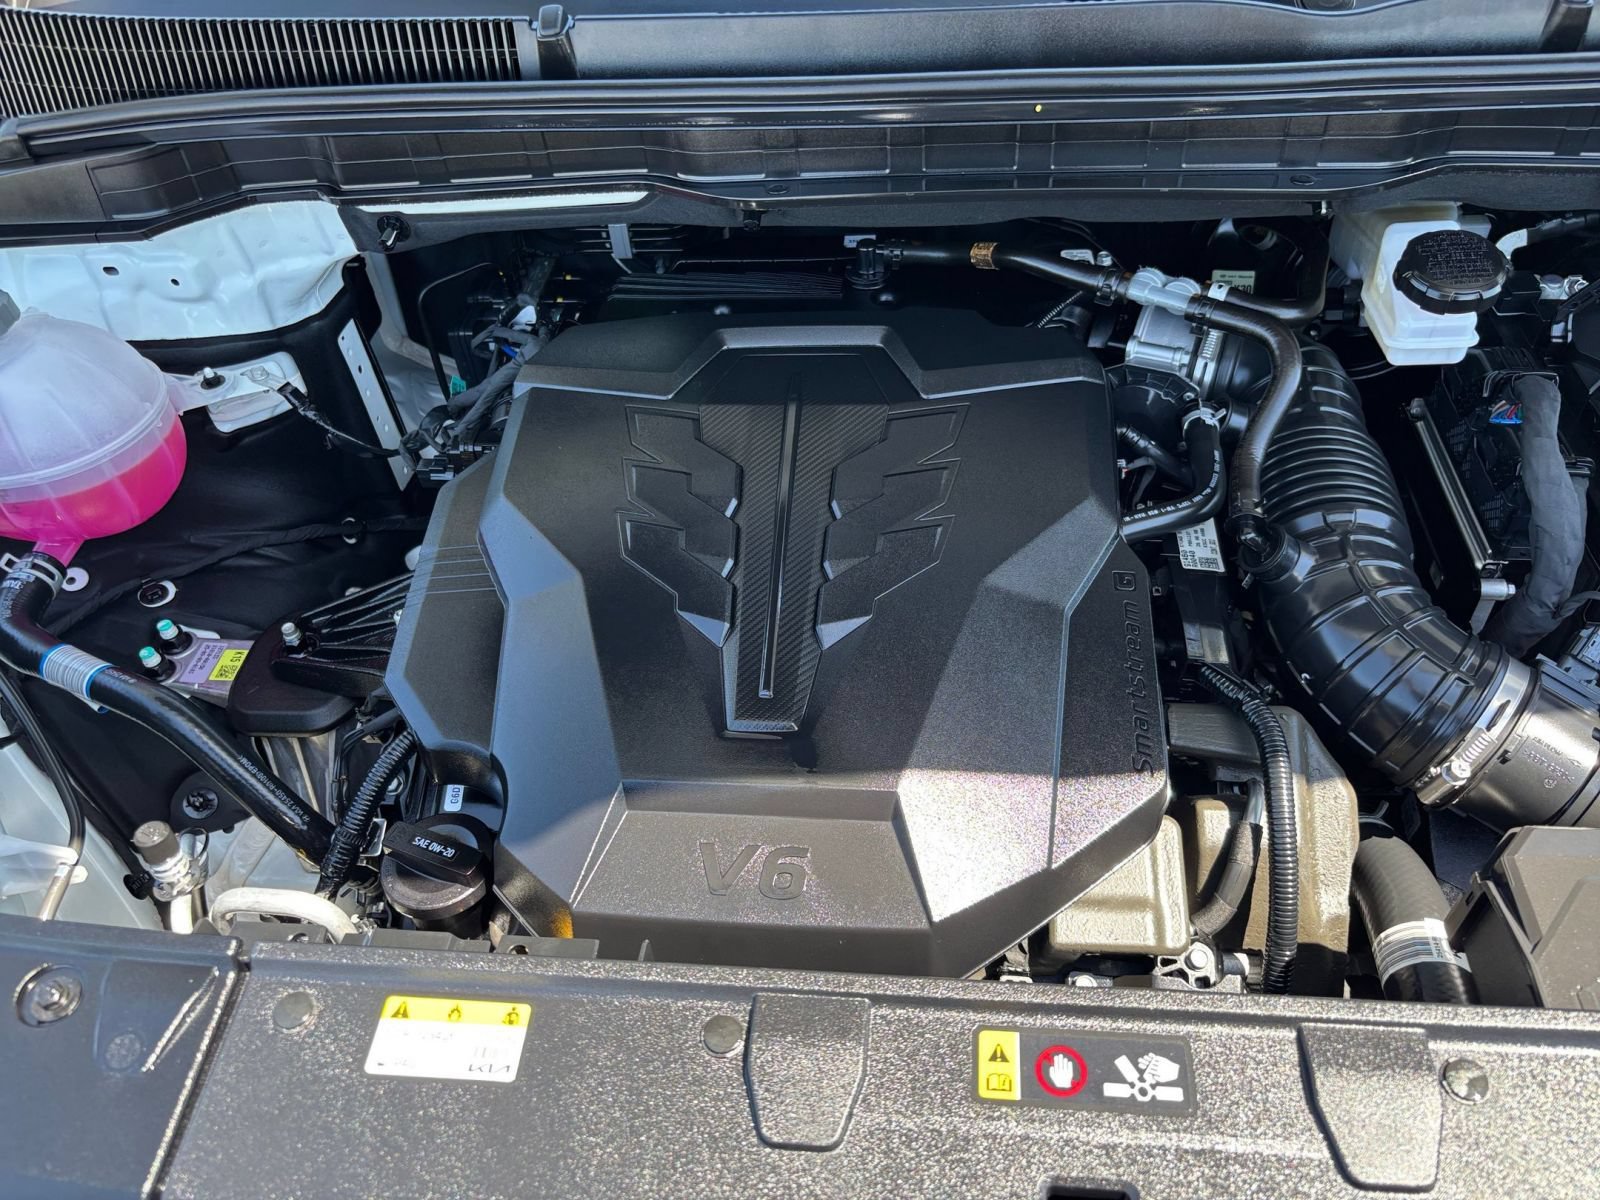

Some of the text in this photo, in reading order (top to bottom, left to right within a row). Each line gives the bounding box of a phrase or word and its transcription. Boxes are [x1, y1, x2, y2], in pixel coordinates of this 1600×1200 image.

[231, 651, 245, 662] K15
[1122, 599, 1153, 773] Smartstream
[412, 836, 455, 857] SAE 0W-20
[697, 840, 811, 901] V6
[468, 1063, 510, 1073] KIA
